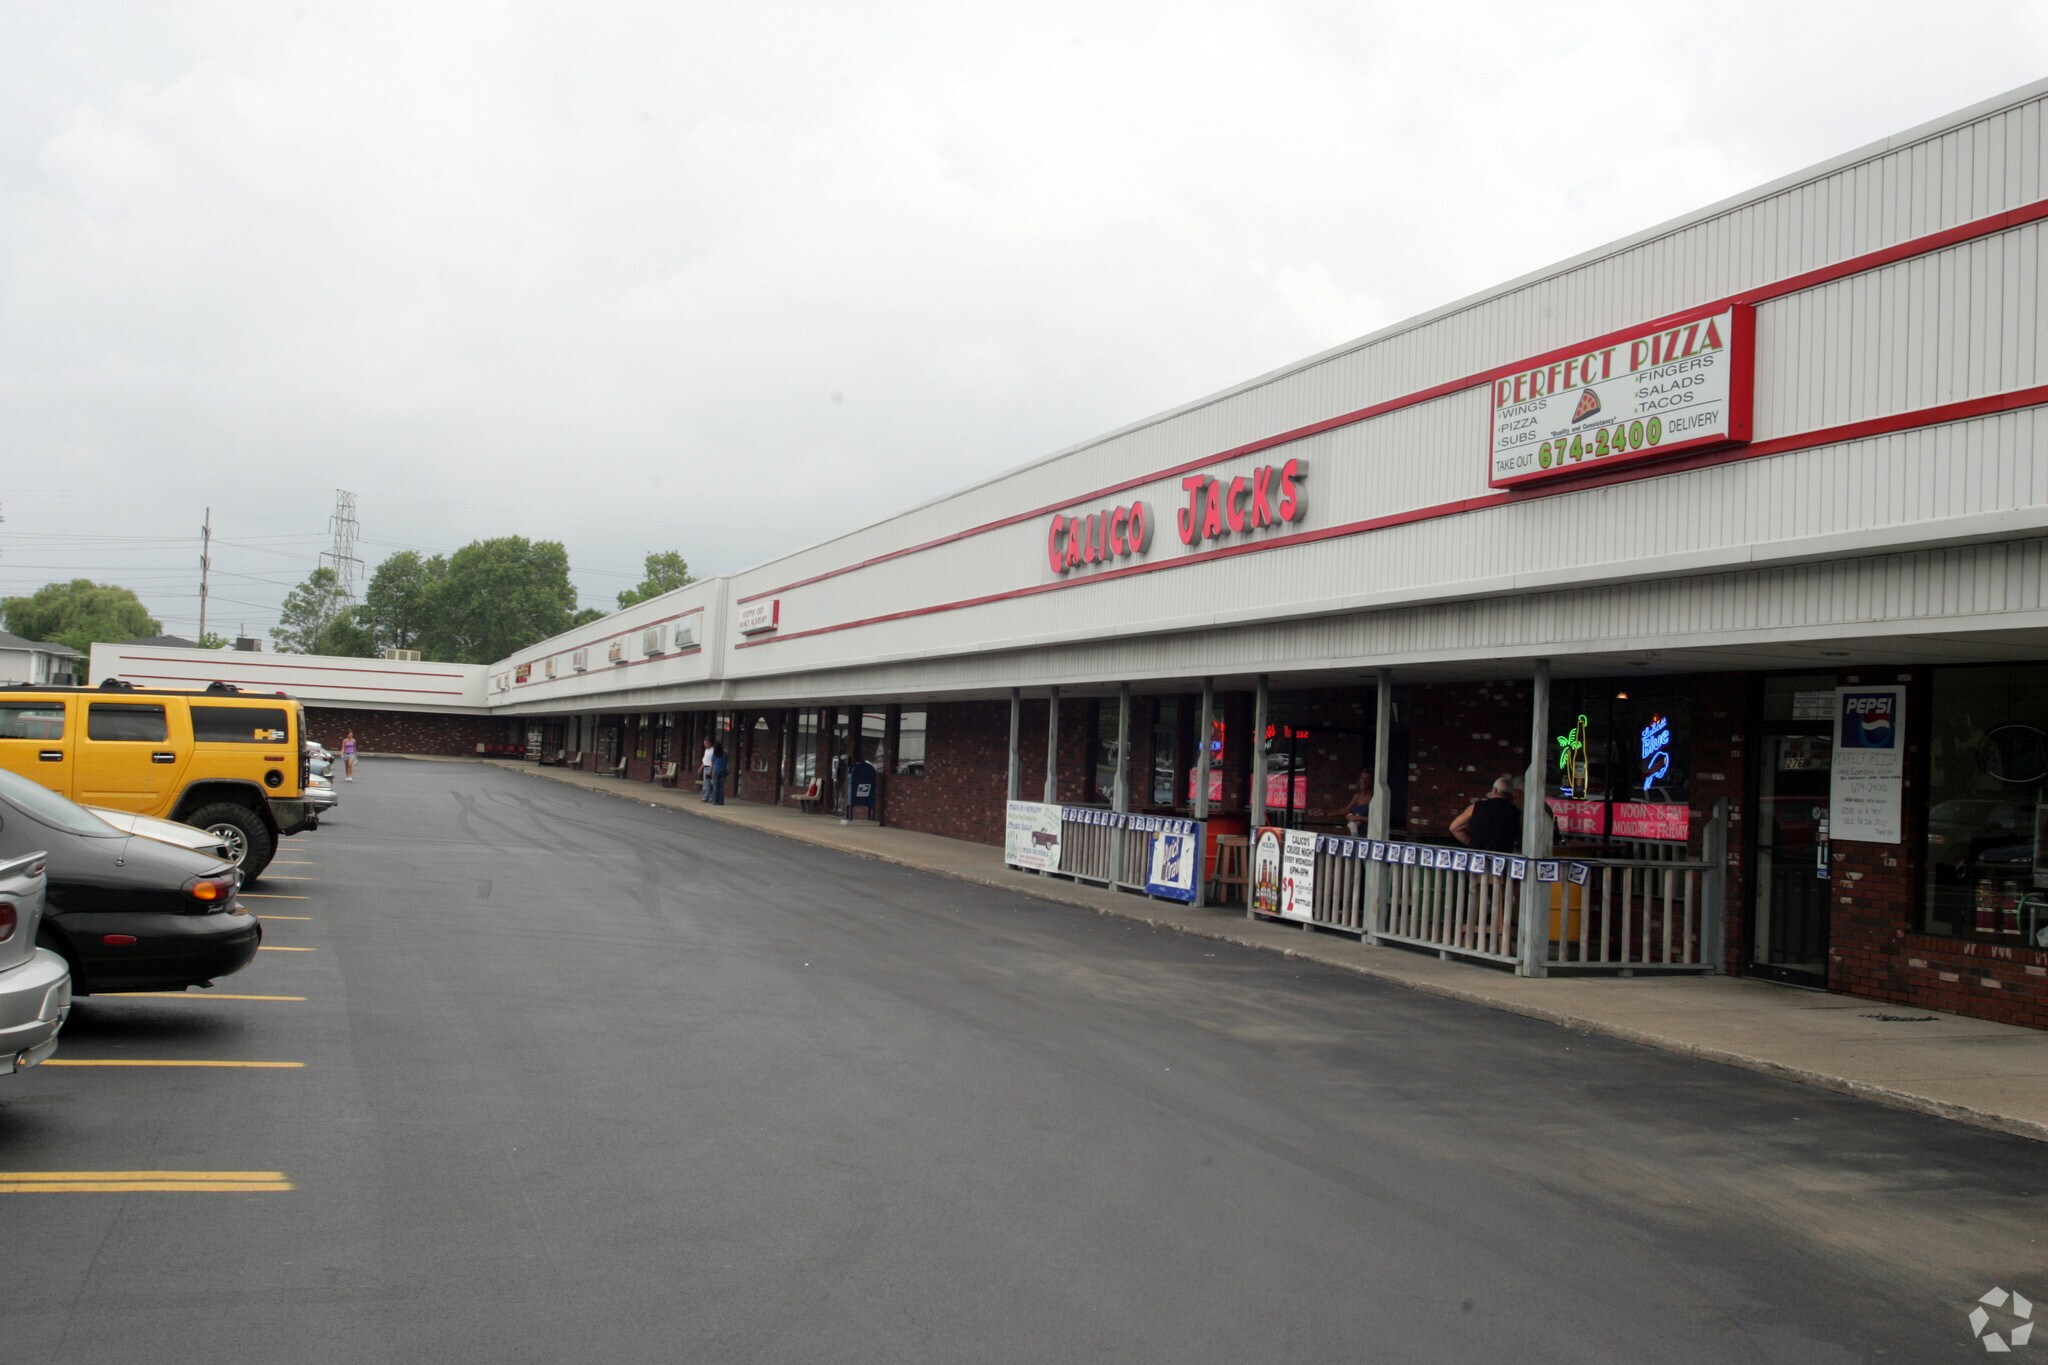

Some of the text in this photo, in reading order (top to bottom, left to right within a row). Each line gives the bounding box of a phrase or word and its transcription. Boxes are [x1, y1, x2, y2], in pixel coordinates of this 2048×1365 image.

[1497, 317, 1723, 408] PERFECT PIZZA
[1639, 355, 1714, 383] FINGERS
[1638, 374, 1705, 398] SALADS
[1502, 400, 1547, 419] WINGS
[1639, 391, 1694, 412] TACOS
[1501, 417, 1538, 433] PIZZA
[1669, 410, 1719, 433] DELIVERY
[1501, 430, 1537, 447] SUBS
[1538, 416, 1662, 469] 674-2400
[1496, 454, 1533, 473] TAKE OUT
[1048, 458, 1308, 573] CALICO JACKS
[1846, 698, 1891, 713] PEPSI
[254, 728, 284, 741] H2
[1642, 730, 1669, 758] Blue
[1786, 758, 1803, 769] 276
[1869, 752, 1898, 766] PIZZA
[1552, 802, 1601, 816] APPY
[1620, 803, 1646, 818] NOON
[1556, 816, 1597, 831] OUR
[1613, 821, 1649, 836] MONDAY
[1657, 822, 1689, 838] FRIDAY
[1292, 835, 1310, 847] CALICO'S
[1286, 845, 1301, 855] CRUISE
